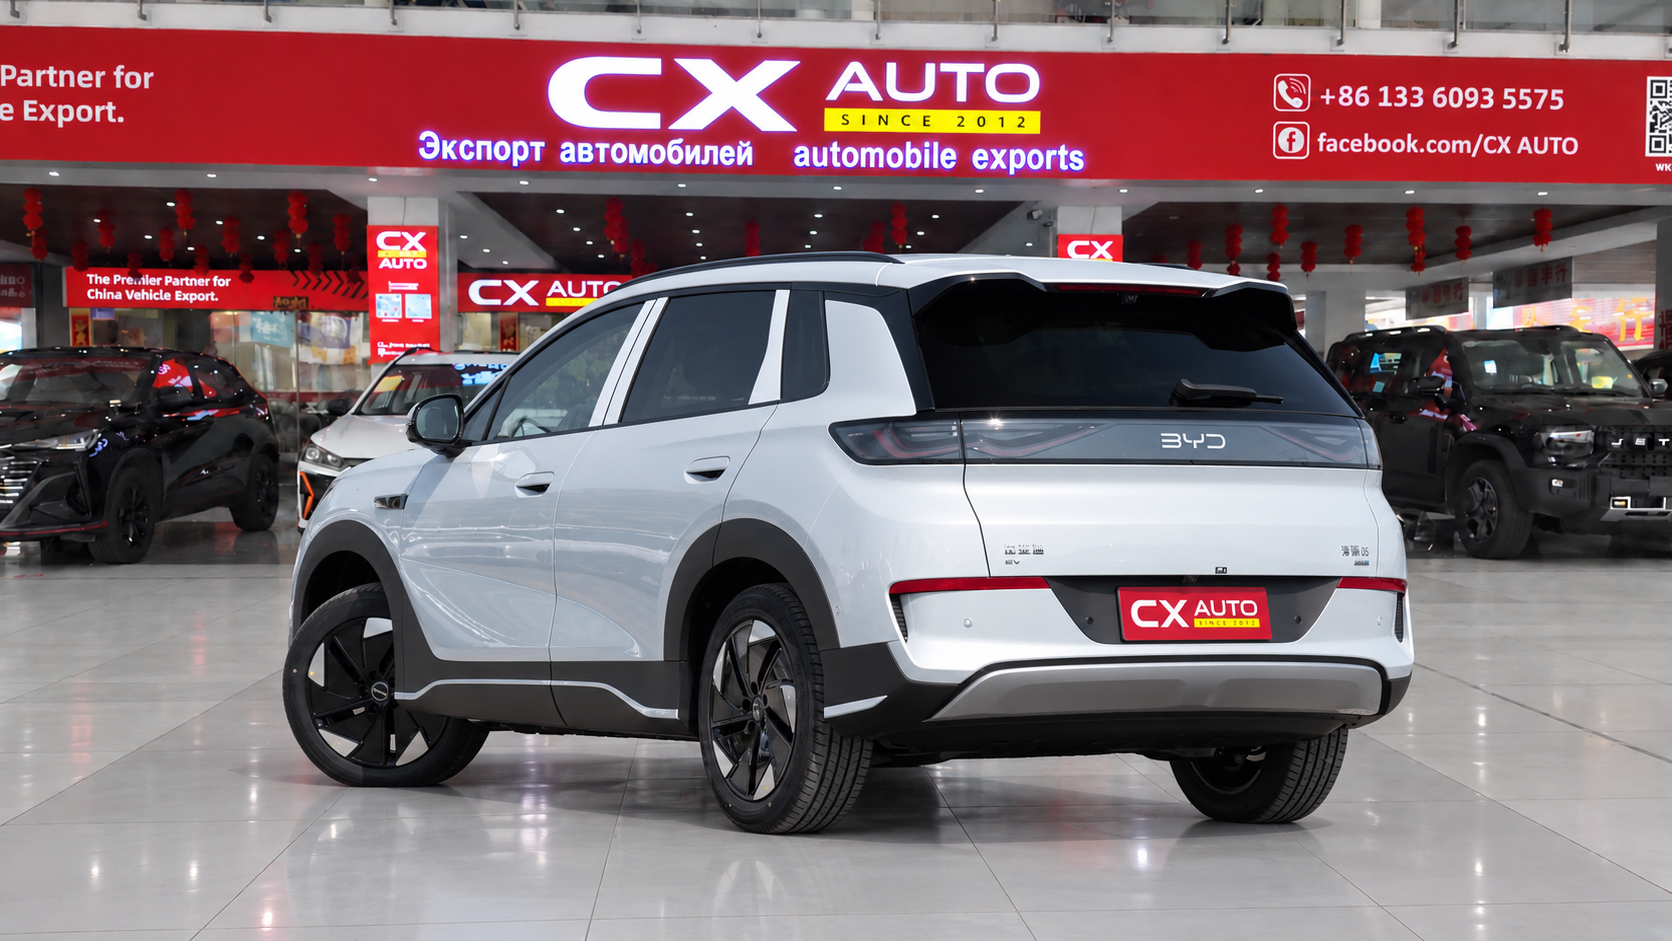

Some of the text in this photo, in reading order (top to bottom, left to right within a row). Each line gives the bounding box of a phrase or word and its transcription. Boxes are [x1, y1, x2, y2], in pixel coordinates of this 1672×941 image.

[0, 64, 155, 89] Partner for
[547, 56, 1040, 132] CX AUTO
[1320, 85, 1564, 110] +86 133 6093 5575
[23, 99, 125, 128] Export.
[841, 114, 1026, 128] SINCE 2012
[418, 130, 753, 168] Экспорт автомобилей
[1317, 132, 1579, 158] facebook.com/CX AUTO
[794, 140, 1085, 176] automobile exports
[376, 231, 427, 252] CX
[1066, 240, 1113, 259] CX
[378, 257, 427, 269] AUTO
[86, 273, 231, 287] The Premier Partner for
[468, 279, 540, 306] CX
[86, 288, 219, 303] China Vehicle Export.
[1160, 432, 1226, 449] BYD
[1130, 599, 1258, 628] CX AUTO
